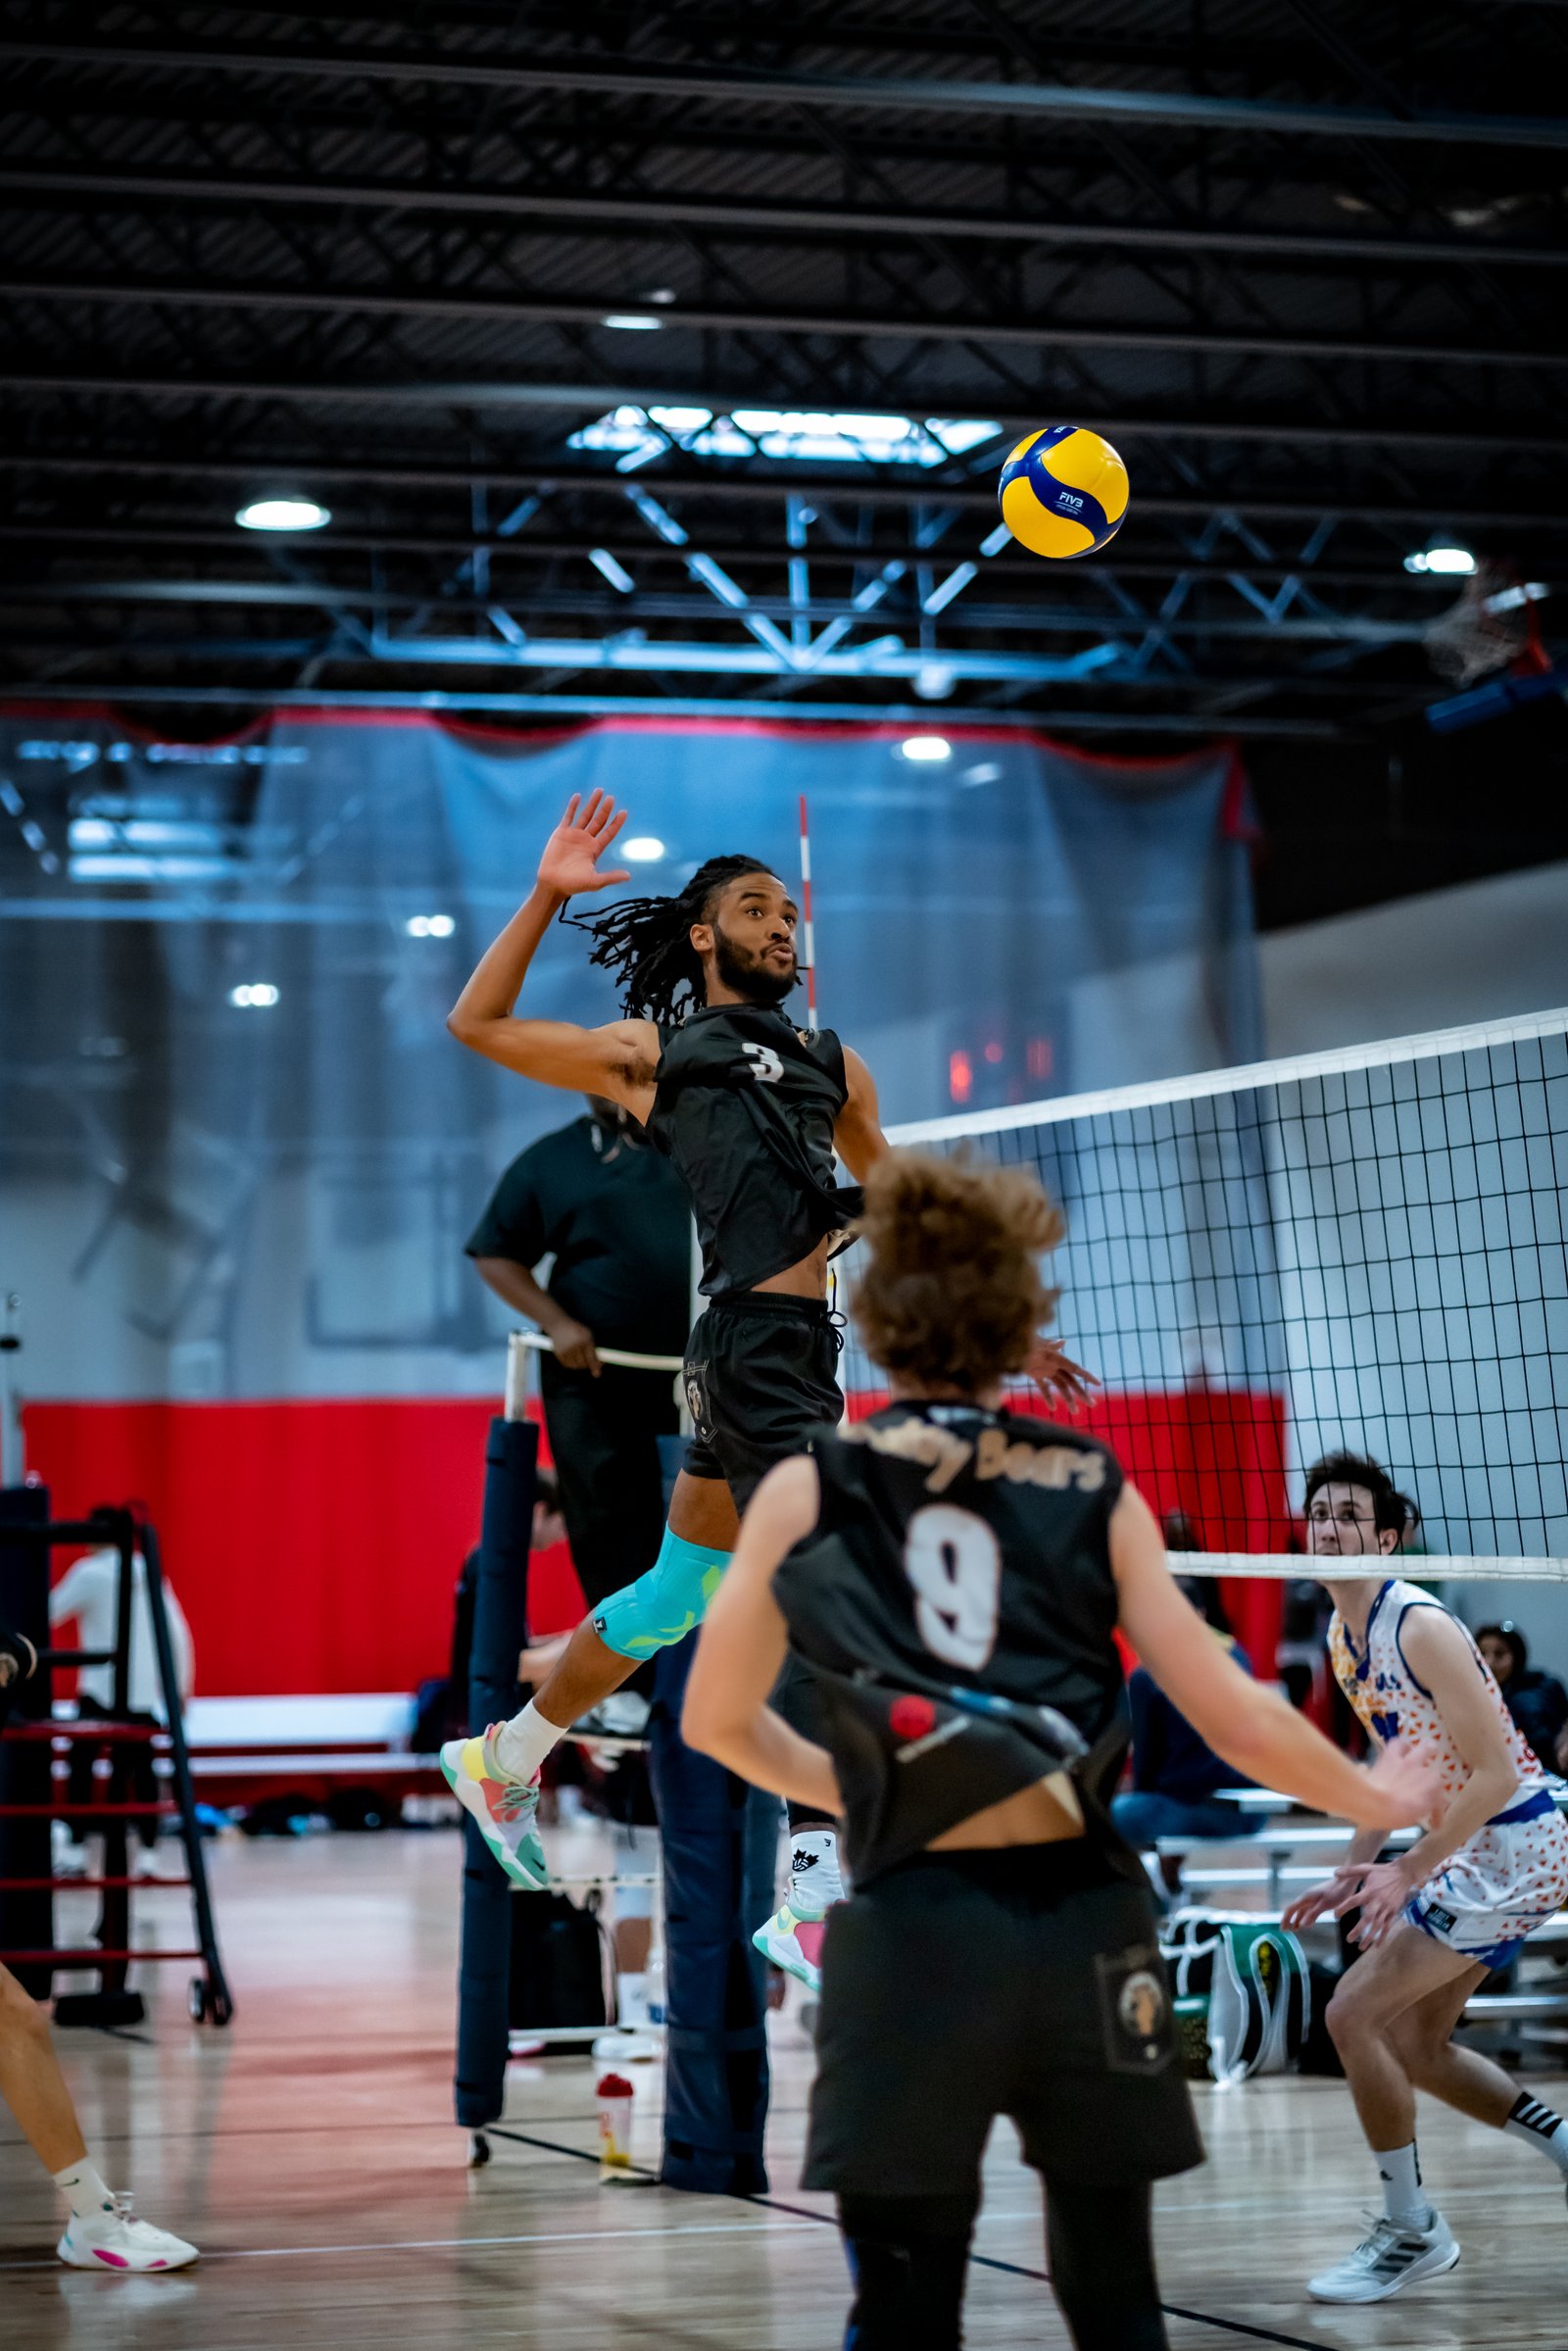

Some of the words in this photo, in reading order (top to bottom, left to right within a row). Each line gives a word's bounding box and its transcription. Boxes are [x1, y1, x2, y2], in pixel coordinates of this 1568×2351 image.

[1059, 491, 1084, 508] FIVB
[742, 1042, 784, 1083] 3
[906, 1504, 1001, 1672] 9
